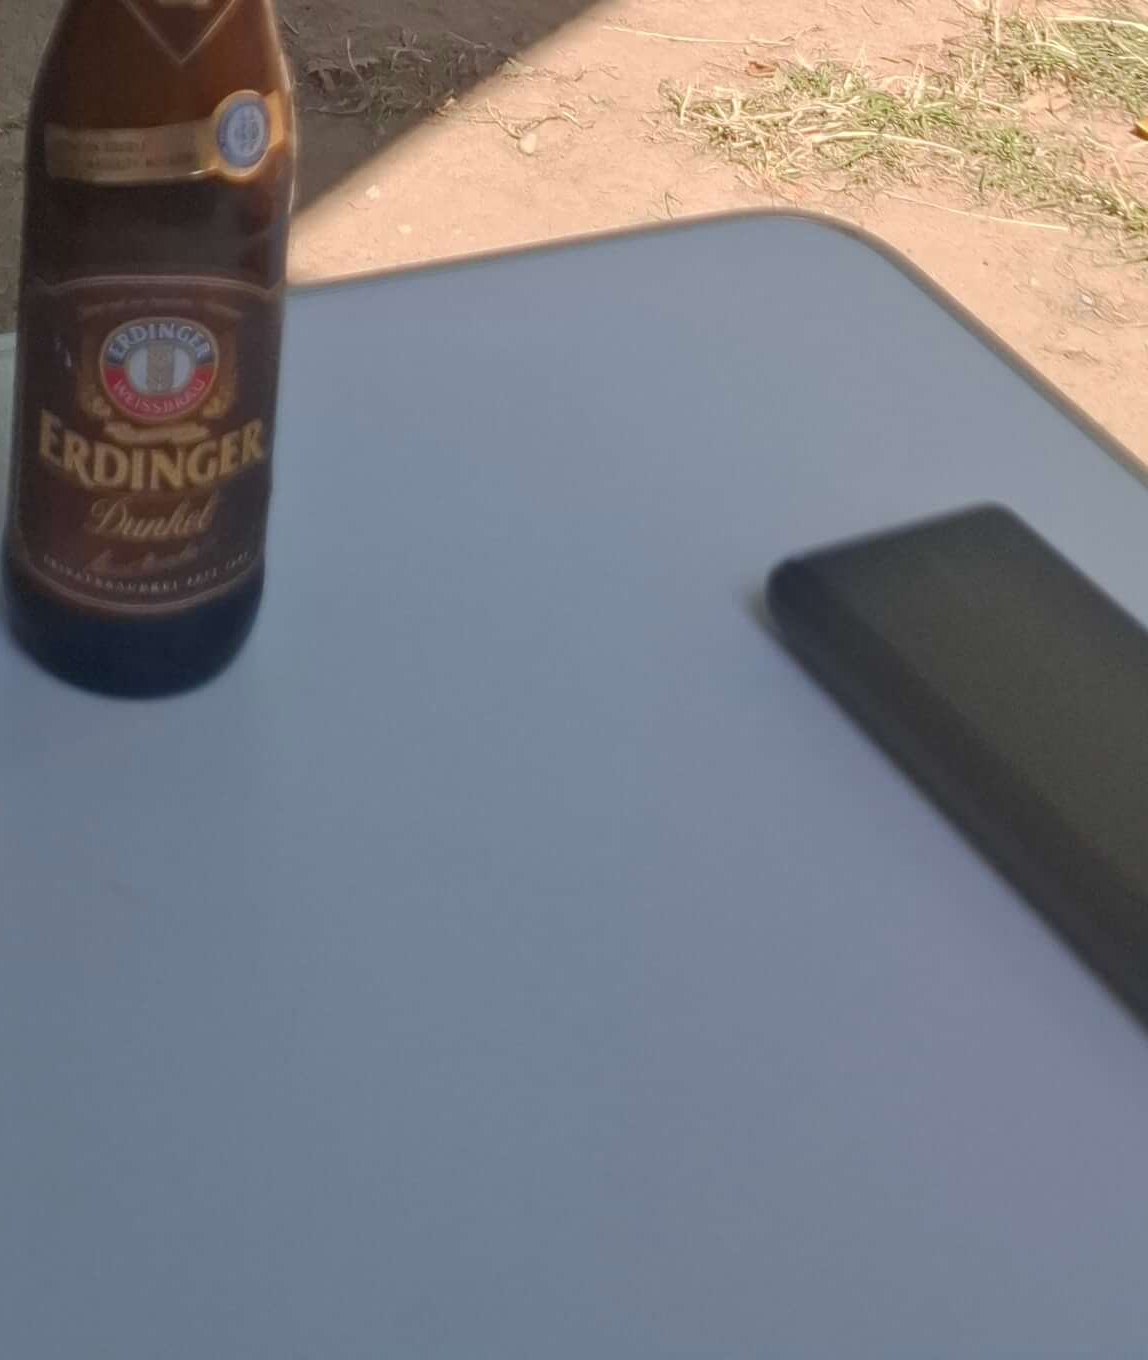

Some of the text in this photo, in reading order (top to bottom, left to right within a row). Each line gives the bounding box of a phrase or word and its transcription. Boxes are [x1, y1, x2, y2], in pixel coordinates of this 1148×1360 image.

[108, 323, 212, 360] ERDINGER
[40, 410, 263, 490] ERDINGER
[90, 494, 216, 538] Dunkel
